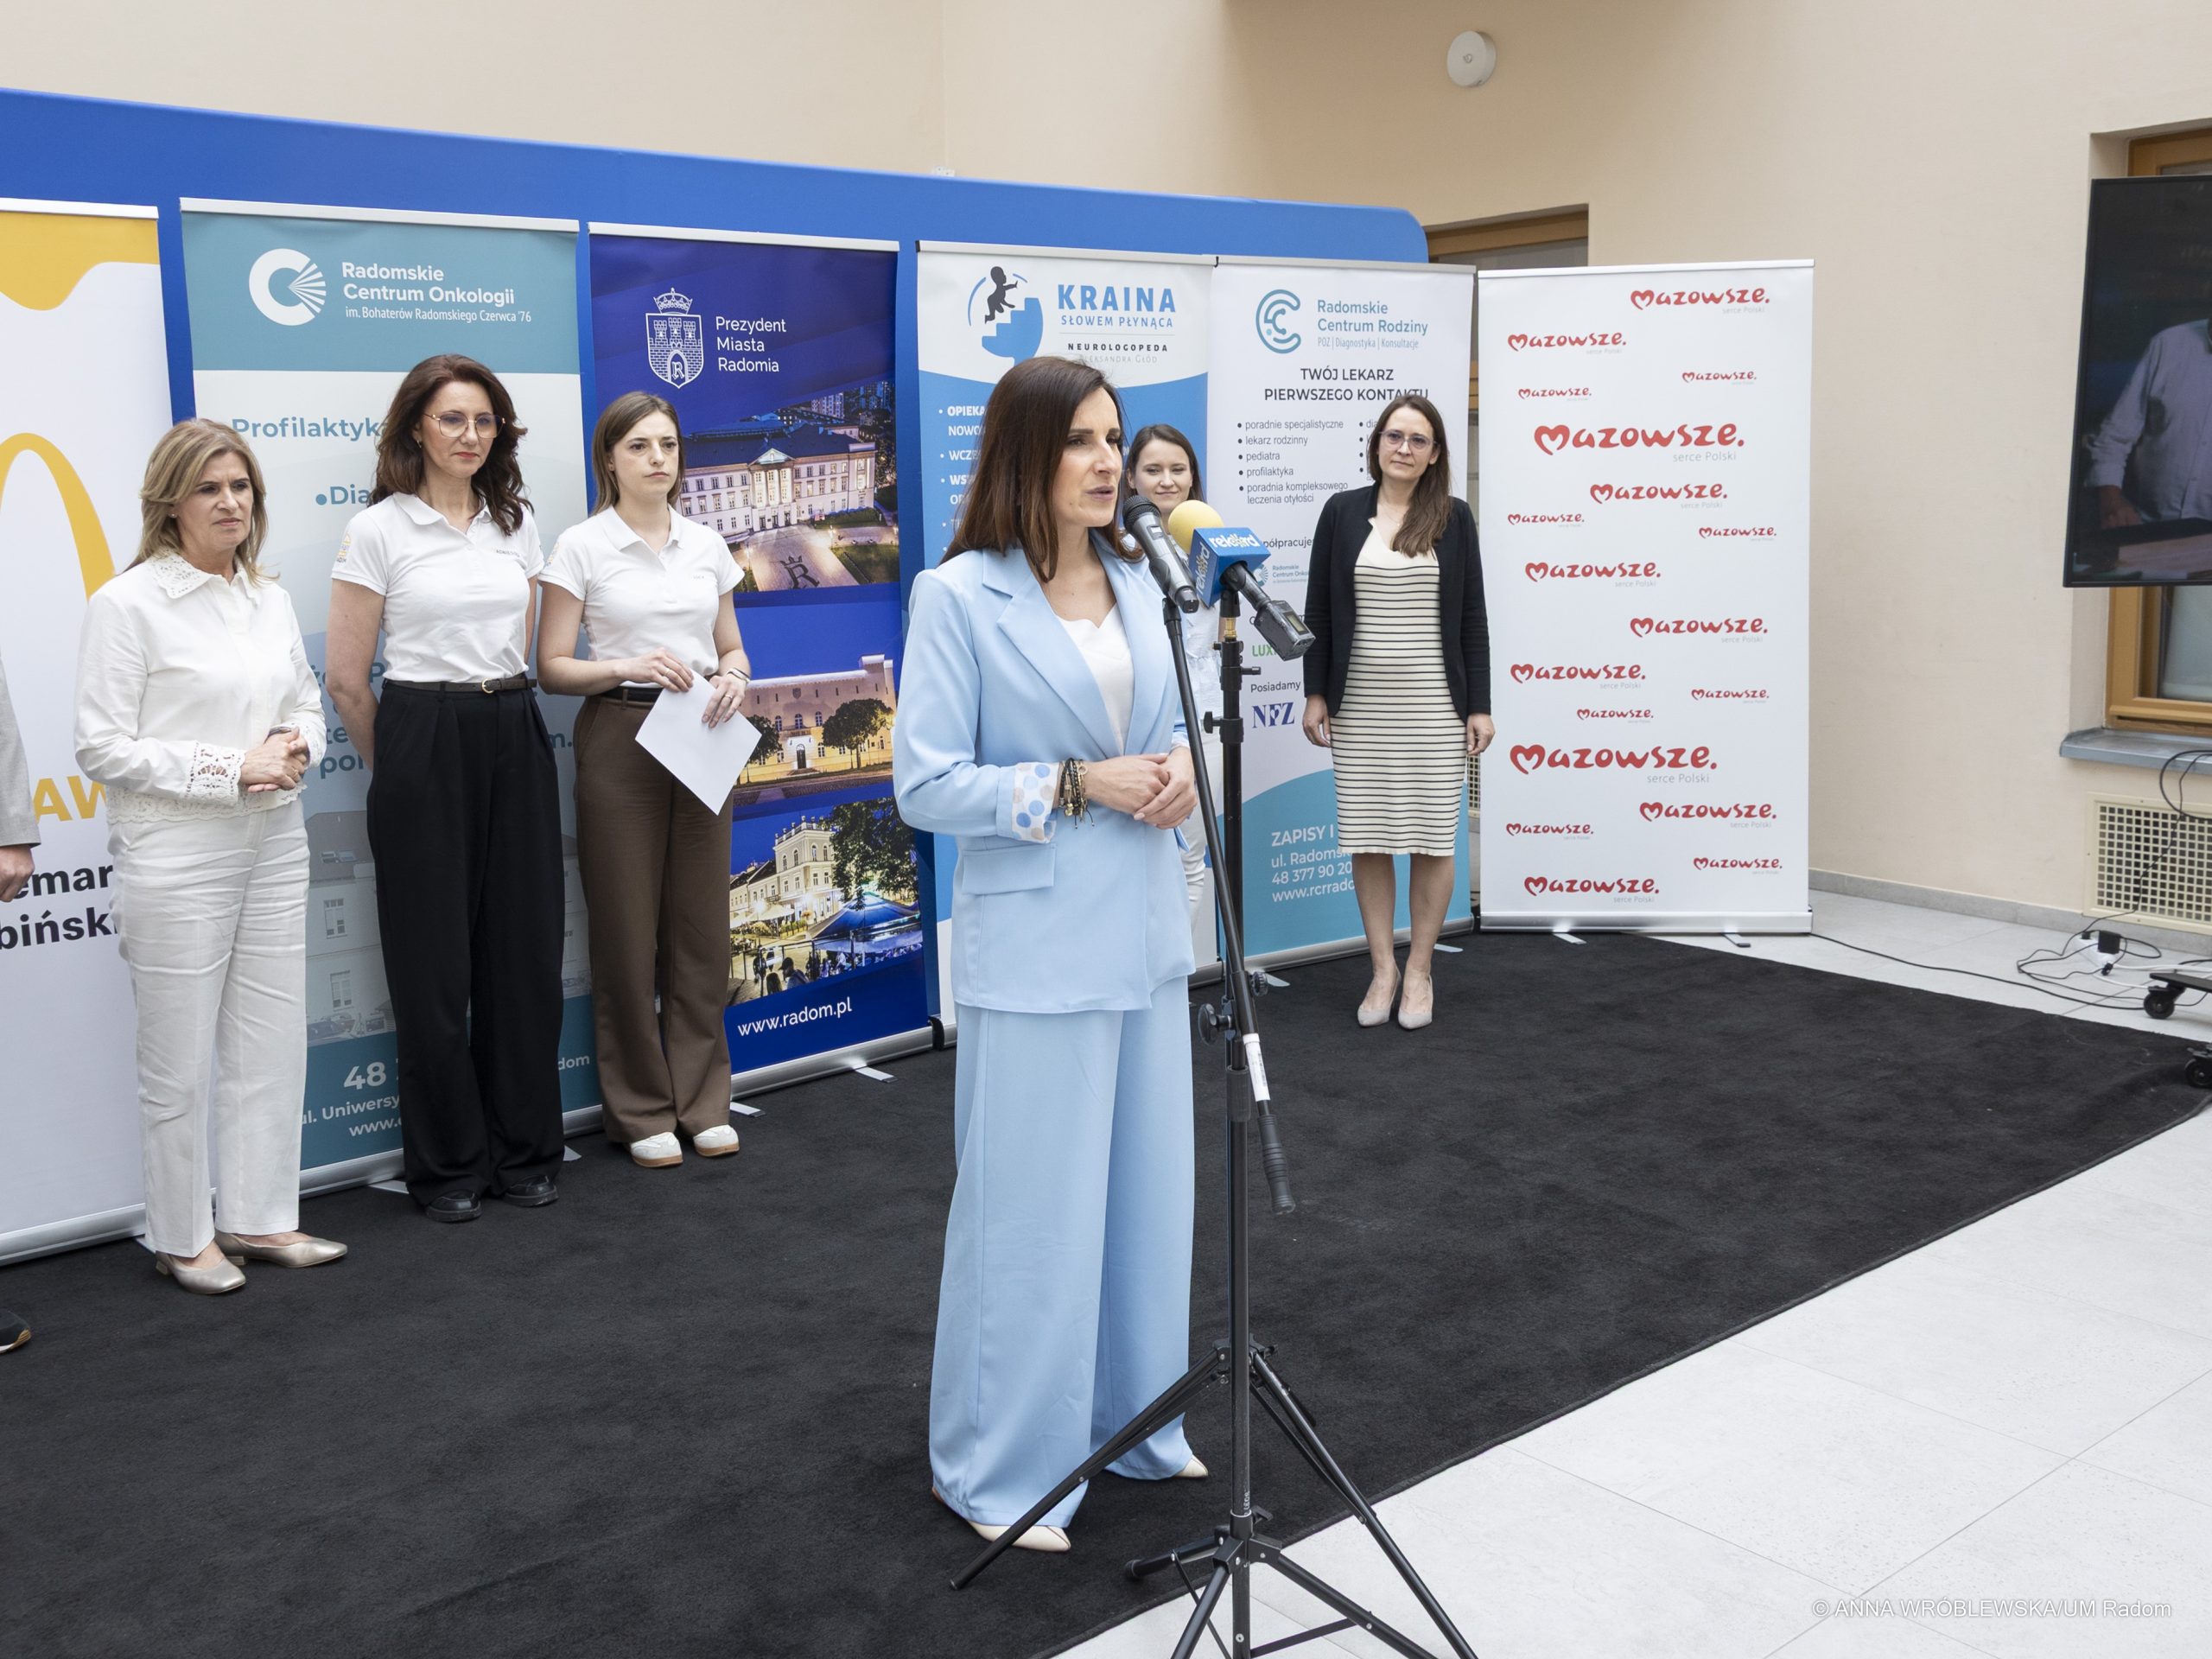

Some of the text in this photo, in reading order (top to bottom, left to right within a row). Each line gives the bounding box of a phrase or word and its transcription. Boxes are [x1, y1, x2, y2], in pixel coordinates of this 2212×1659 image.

[341, 262, 444, 282] Radomskie
[344, 283, 514, 308] Centrum Onkologii
[1058, 283, 1176, 313] KRAINA
[1630, 288, 1770, 310] Mazowsze.
[346, 306, 360, 318] im.
[362, 307, 412, 321] Bohaterów
[416, 308, 477, 322] Radomskiego
[480, 310, 516, 322] Czerwca
[1317, 299, 1388, 314] Radomskie
[715, 316, 786, 335] Prezydent
[1061, 315, 1173, 330] SŁOWEM PŁYNĄCA
[1318, 318, 1428, 336] Centrum Rodziny
[716, 337, 765, 352] Miasta
[1068, 343, 1168, 352] NEUROLOGOPEDA
[1318, 337, 1419, 349] POZ Diagnostyka Konsultacje
[1508, 332, 1627, 352] Mazowsze.
[718, 358, 779, 372] Radomia
[1300, 365, 1394, 381] TWÓJ LEKARZ
[1265, 389, 1353, 401] PIERWSZEGO
[232, 417, 386, 442] Profilaktyk
[1245, 420, 1344, 431] poradnie specjalistyczne
[1246, 435, 1308, 447] lekarz rodzinny
[1534, 423, 1745, 455] Mazowsze.
[1246, 451, 1281, 462] pediatra
[1673, 450, 1737, 462] serce Polski
[1247, 467, 1294, 478] profilaktyka
[1247, 481, 1348, 494] poradnia kompleksowego
[1590, 484, 1728, 504] Mazowsze.
[1248, 493, 1314, 505] leczenia otyłości
[1525, 562, 1661, 582] Mazowsze.
[1630, 617, 1768, 638] Mazowsze.
[1510, 663, 1646, 683] Mazowsze.
[1250, 681, 1301, 693] Posiadamy
[1252, 701, 1295, 728] NFZ
[1510, 744, 1718, 775] Mazowsze.
[1646, 773, 1710, 784] serce Polski
[1639, 802, 1777, 822] Mazowsze.
[1271, 825, 1326, 847] ZAPISY
[1271, 854, 1287, 868] ul.
[1272, 871, 1289, 886] 48
[1292, 868, 1314, 883] 377
[1318, 865, 1335, 879] 90
[1524, 876, 1660, 897] Mazowsze.
[737, 995, 853, 1037] www.radom.pl
[344, 1062, 386, 1090] 48
